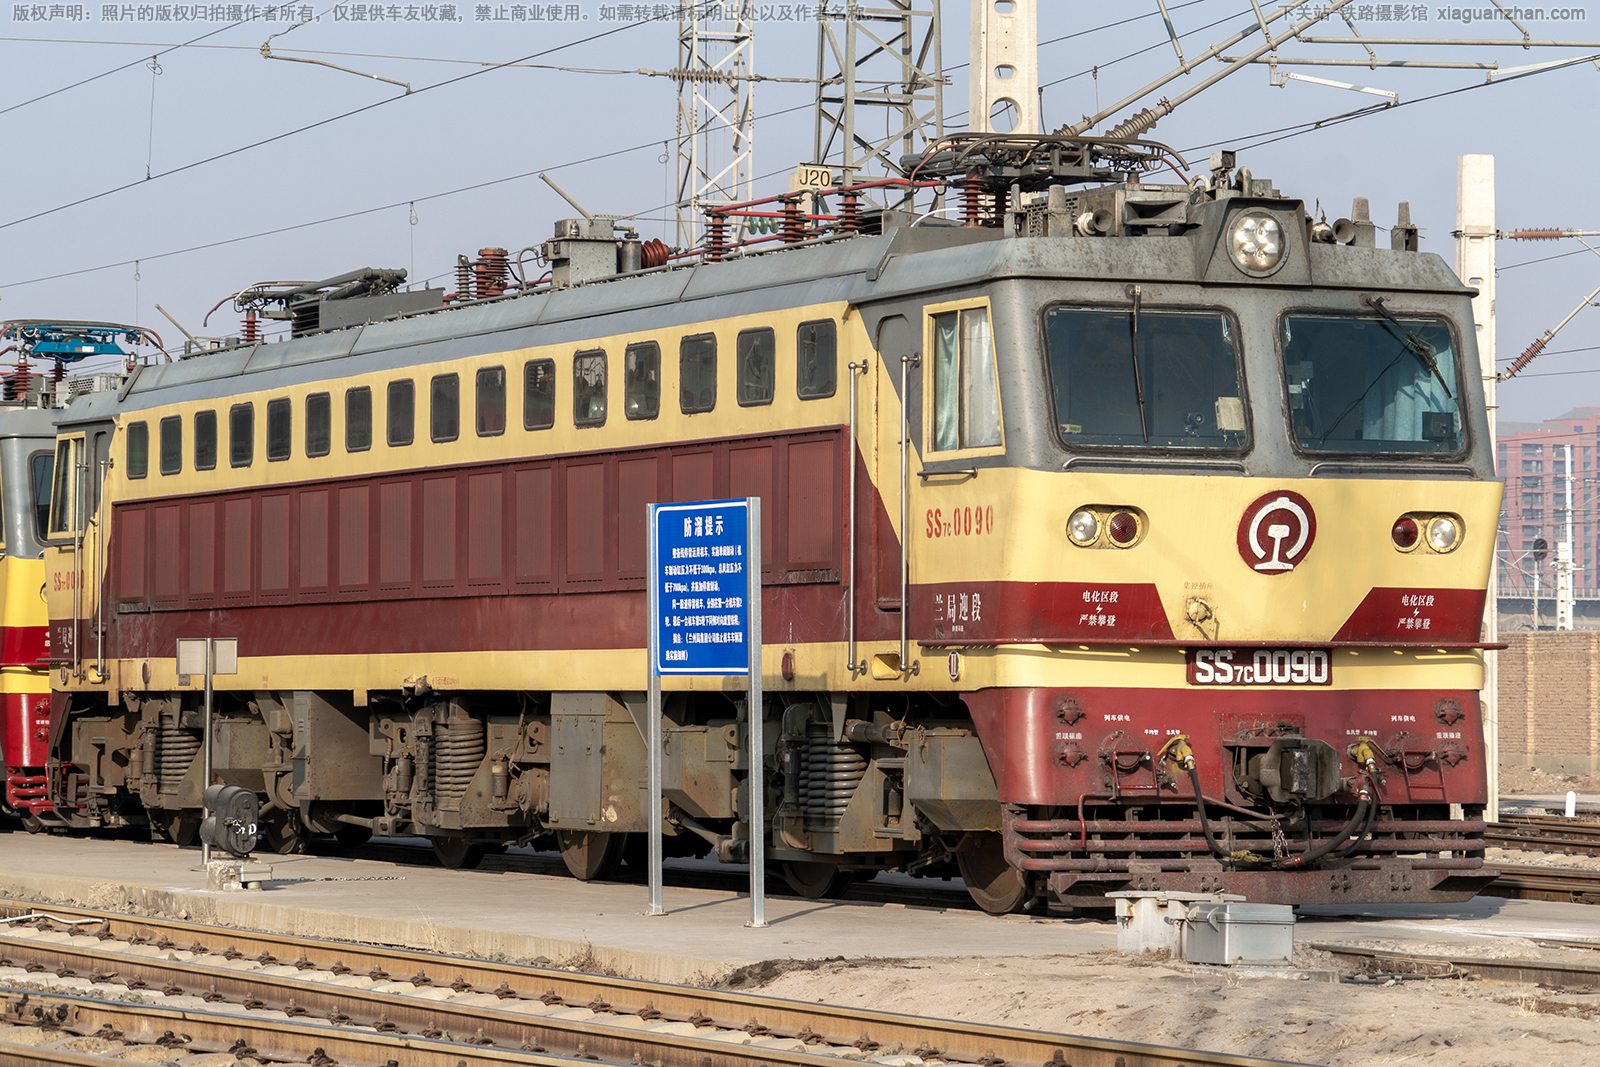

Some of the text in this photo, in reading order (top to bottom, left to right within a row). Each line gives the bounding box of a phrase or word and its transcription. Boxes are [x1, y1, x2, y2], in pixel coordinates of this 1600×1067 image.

[799, 169, 831, 187] J20
[683, 515, 724, 538] 防溜提示
[1081, 589, 1119, 603] 电化区段
[1401, 594, 1435, 607] 电化区段
[933, 592, 982, 624] 兰局迎段
[1078, 613, 1116, 627] 严禁攀登
[1396, 617, 1431, 630] 严禁攀登
[1195, 650, 1329, 684] SS7C0090
[1103, 714, 1131, 722] 列车供电
